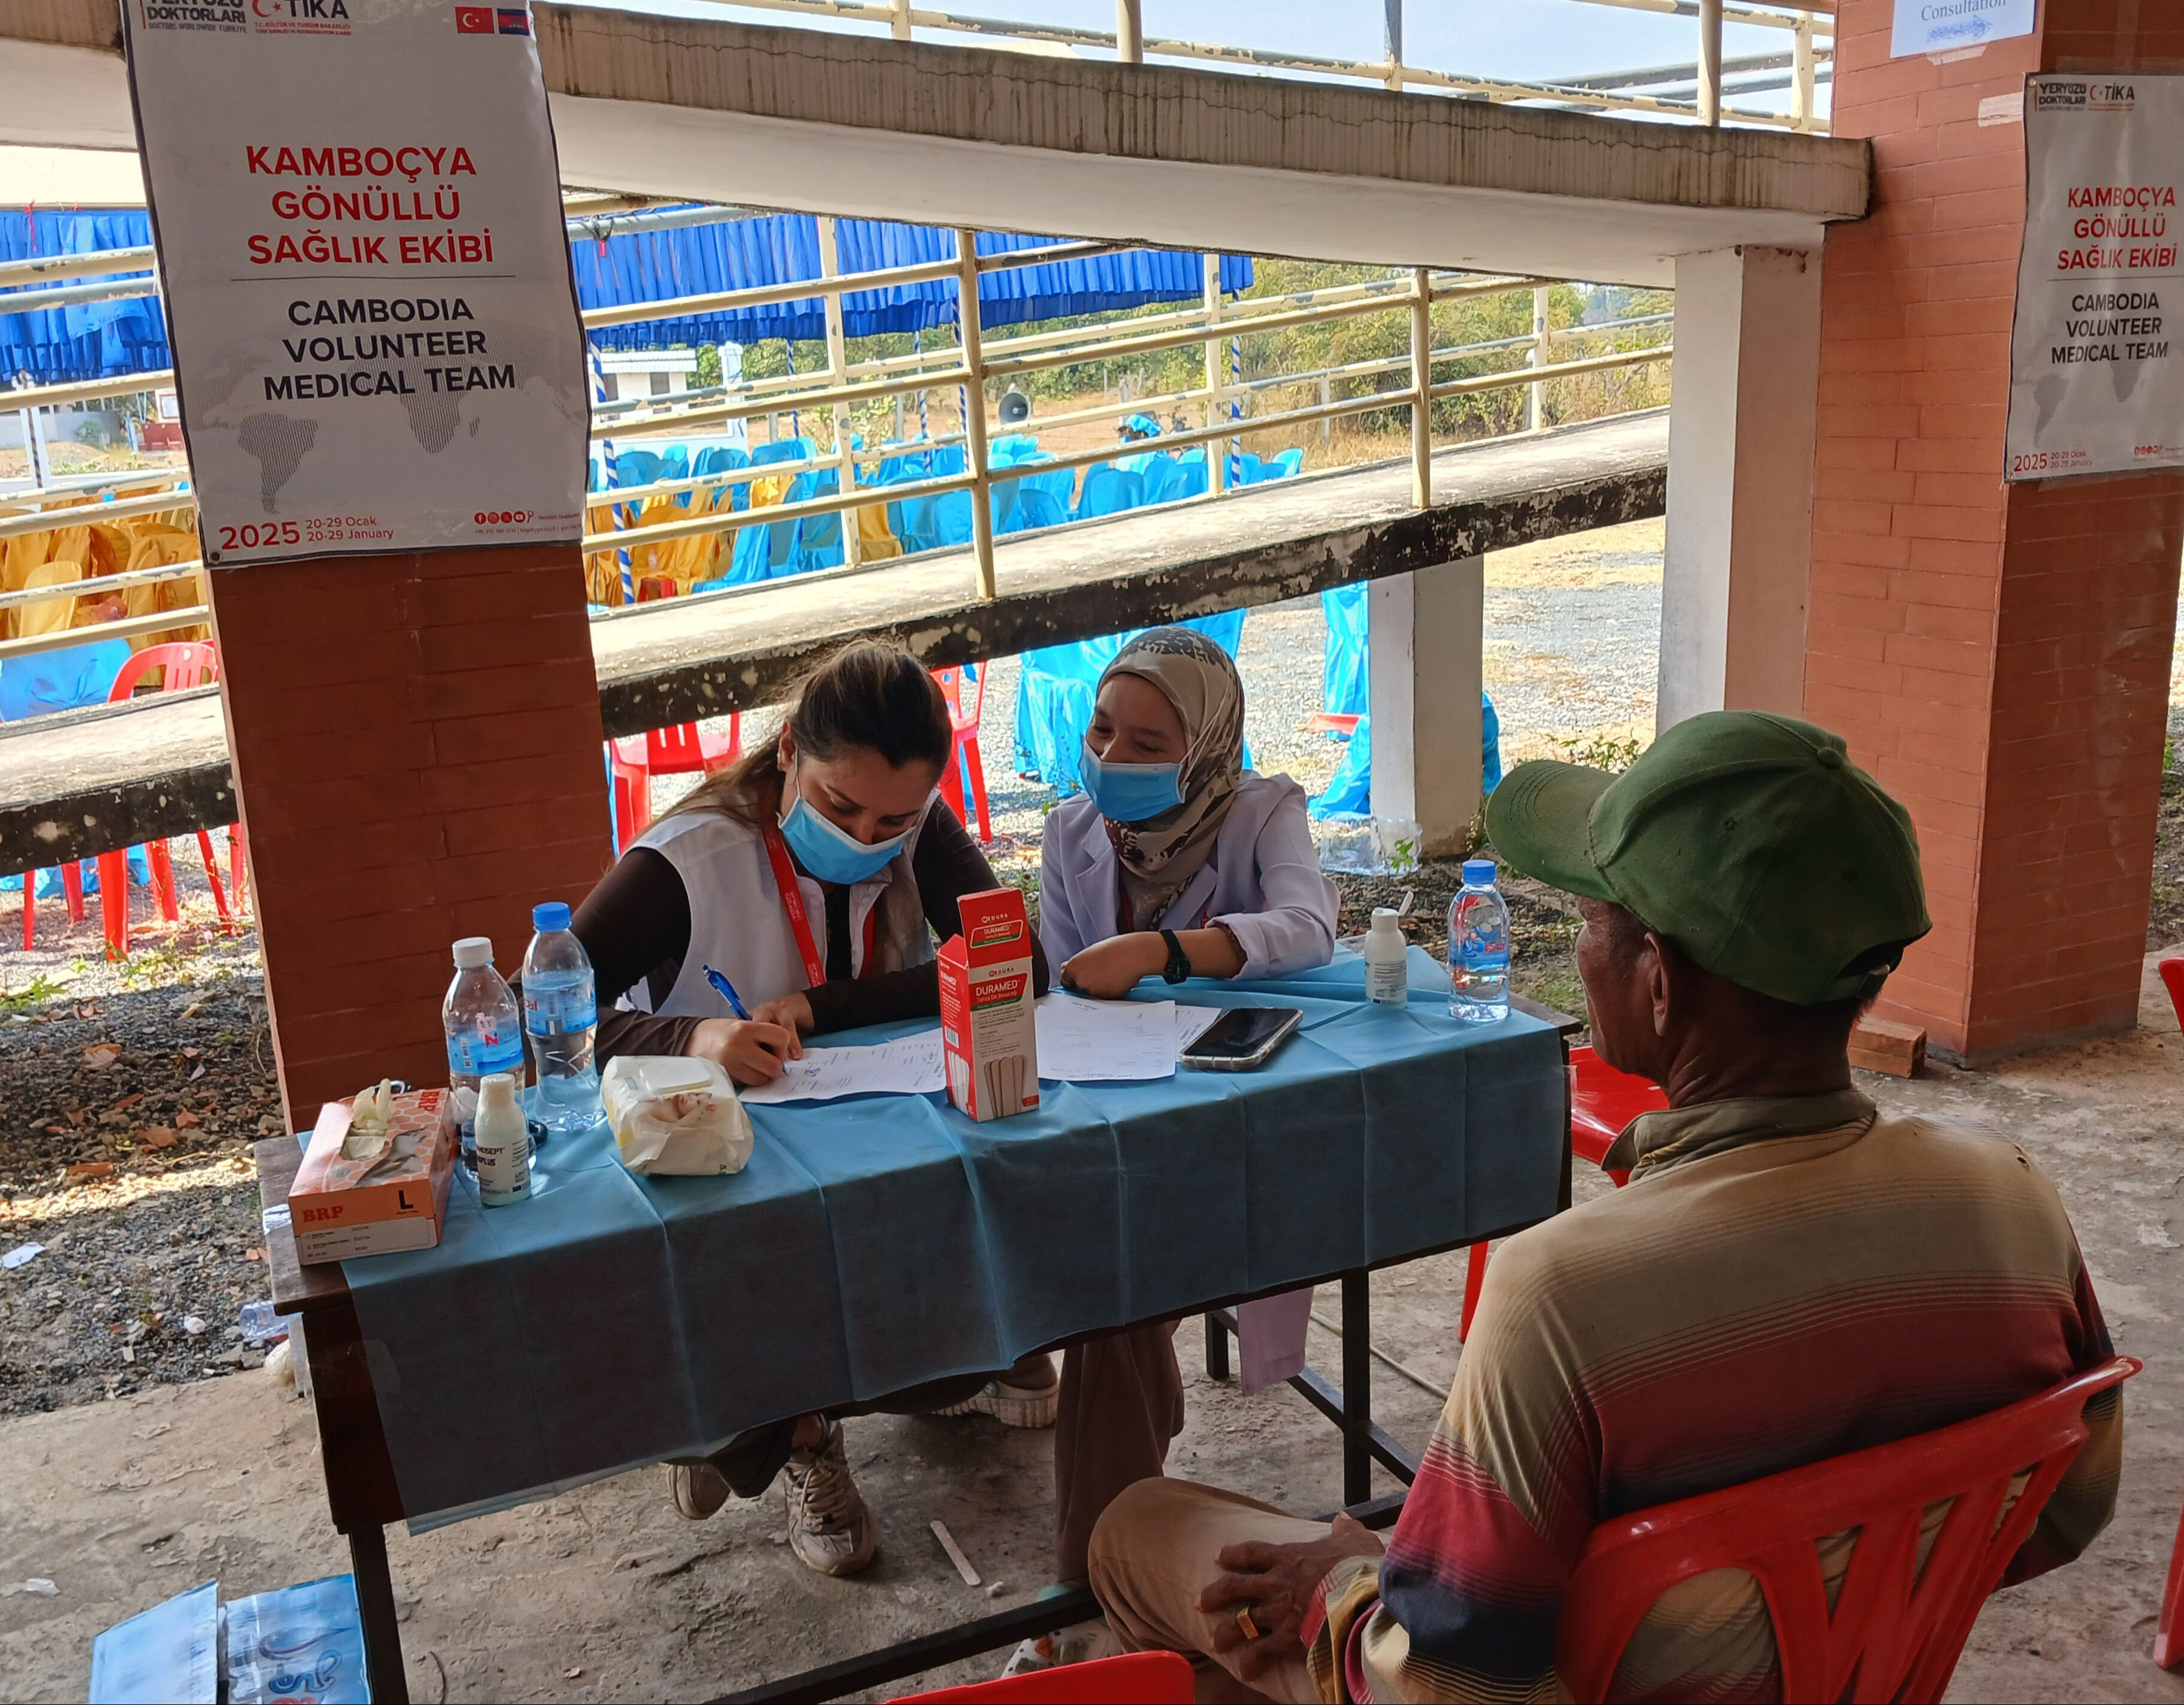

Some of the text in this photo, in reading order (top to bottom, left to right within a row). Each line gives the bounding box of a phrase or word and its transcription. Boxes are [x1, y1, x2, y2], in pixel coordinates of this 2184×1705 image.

[147, 7, 246, 23] DOKTORLARI
[1921, 0, 2006, 21] Consultation
[2038, 95, 2086, 105] DOKTORLARI
[247, 146, 476, 183] KAMBOÇYA
[272, 185, 460, 221] GÖNÜLLÜ
[2068, 186, 2176, 212] KAMBOÇYA
[2074, 212, 2167, 238] GÖNÜLLÜ
[249, 228, 494, 264] SAĞLIK EKİBİ
[2058, 243, 2178, 270] SAĞLIK EKİBİ
[288, 298, 475, 326] CAMBODIA
[2072, 292, 2159, 312] CAMBODIA
[2065, 317, 2162, 338] VOLUNTEER
[282, 330, 487, 363] VOLUNTEER
[2051, 341, 2168, 364] MEDICAL TEAM
[264, 365, 515, 400] MEDICAL TEAM
[2014, 453, 2048, 472] 2025
[2050, 451, 2070, 460] 20-29
[2050, 460, 2069, 469] 20-29
[306, 516, 377, 529] 20-29 Ocak
[219, 520, 301, 550] 2025
[307, 529, 394, 542] 20-29 January
[984, 925, 1010, 935] DURAMED
[976, 979, 1018, 997] DURAMED
[418, 1090, 439, 1112] BRP
[398, 1190, 414, 1210] L
[303, 1206, 344, 1223] BRP
